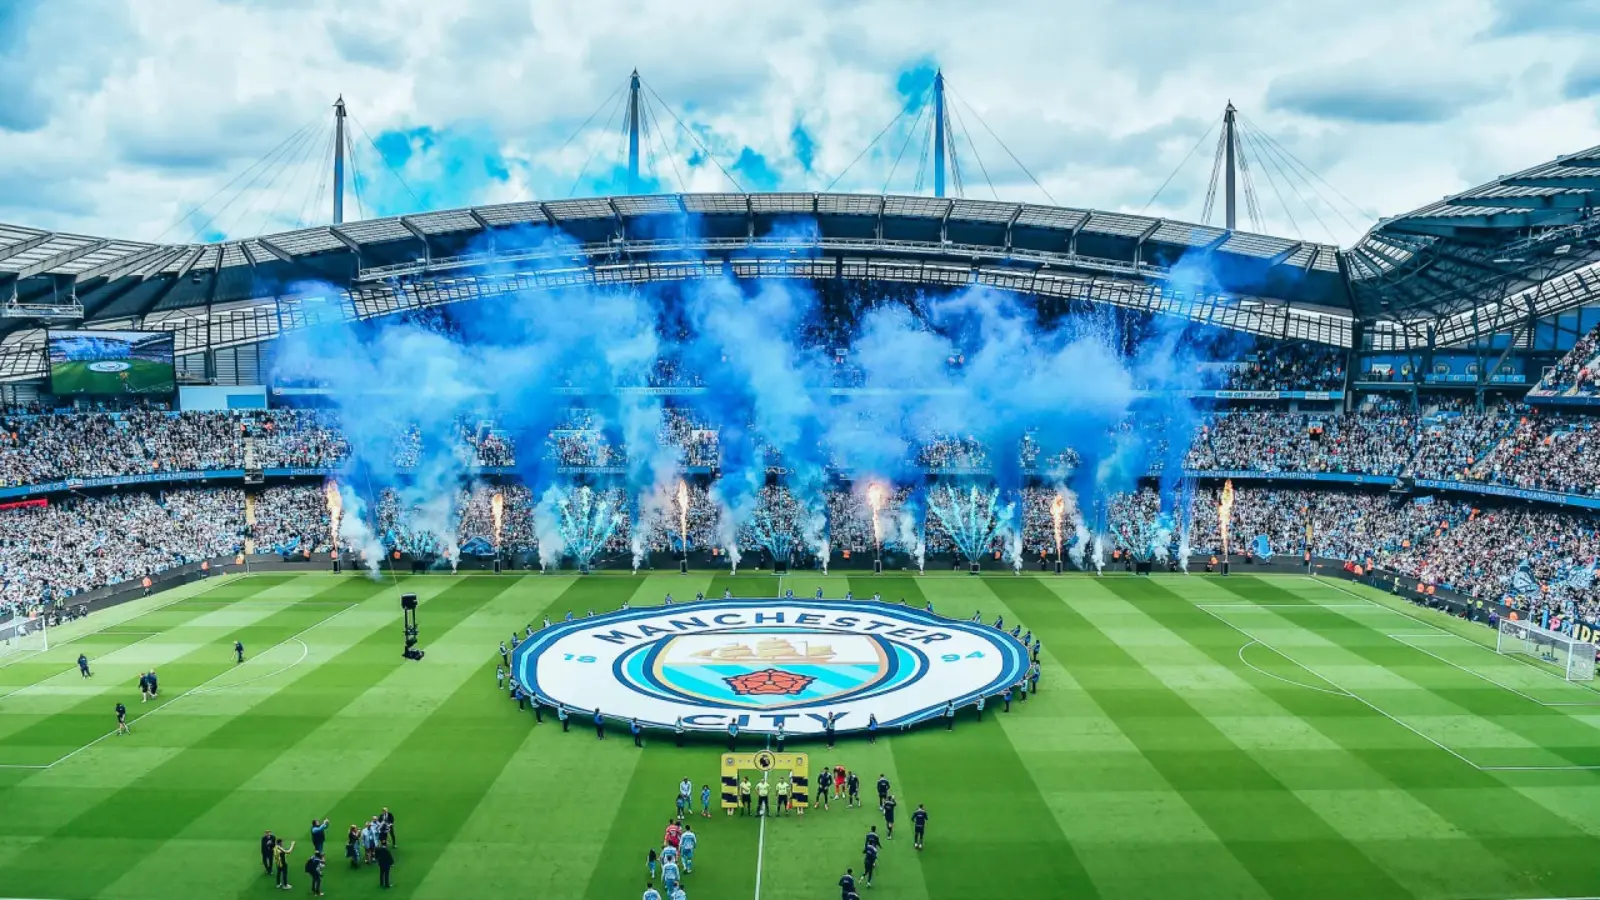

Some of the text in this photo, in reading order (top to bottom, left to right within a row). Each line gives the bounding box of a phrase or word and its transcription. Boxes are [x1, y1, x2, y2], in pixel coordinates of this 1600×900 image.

[154, 471, 205, 480] CHAMPIONS
[593, 612, 952, 645] MANCHESTER
[563, 651, 985, 663] 18 94
[682, 712, 850, 728] CITY
